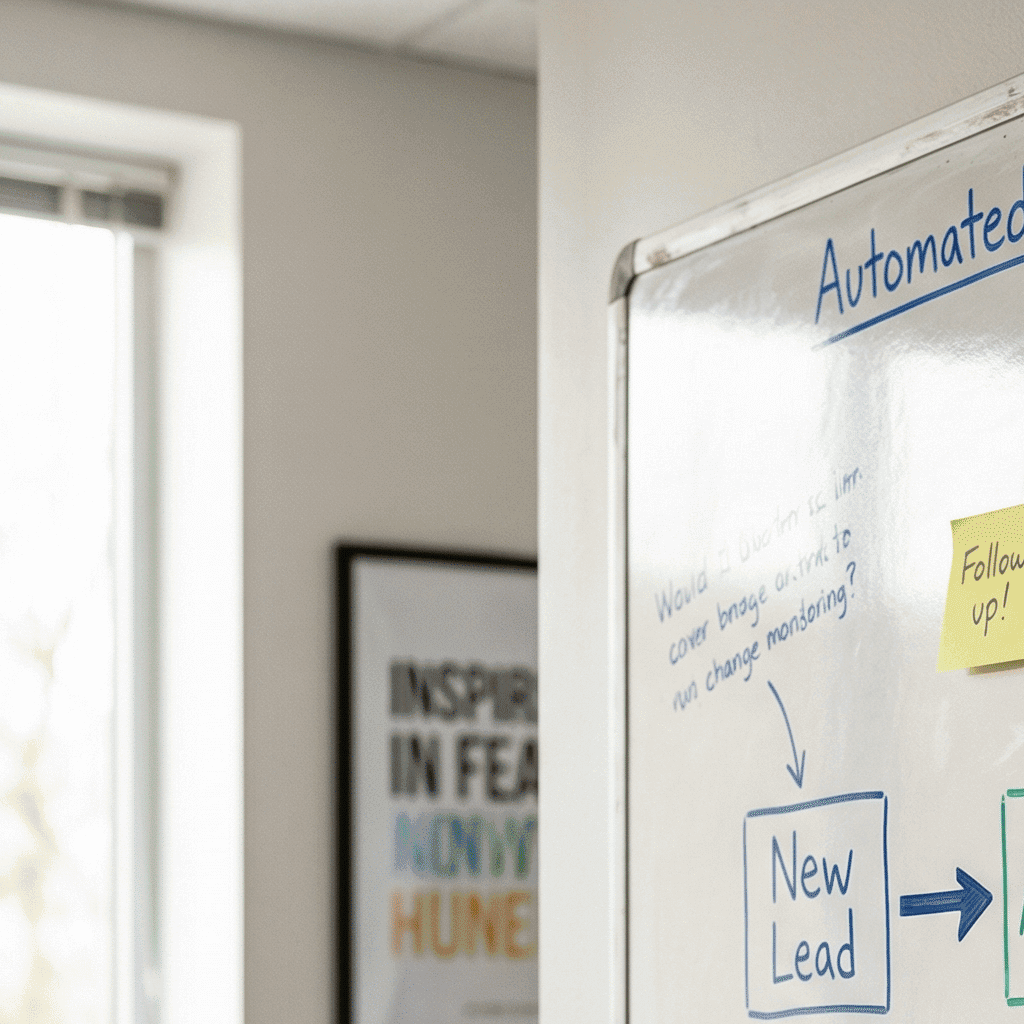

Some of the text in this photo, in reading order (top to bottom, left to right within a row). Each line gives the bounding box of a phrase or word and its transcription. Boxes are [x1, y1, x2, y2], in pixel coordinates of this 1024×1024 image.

[972, 581, 1010, 637] up!
[706, 640, 761, 692] change
[772, 830, 853, 904] New
[772, 907, 856, 984] Lead
